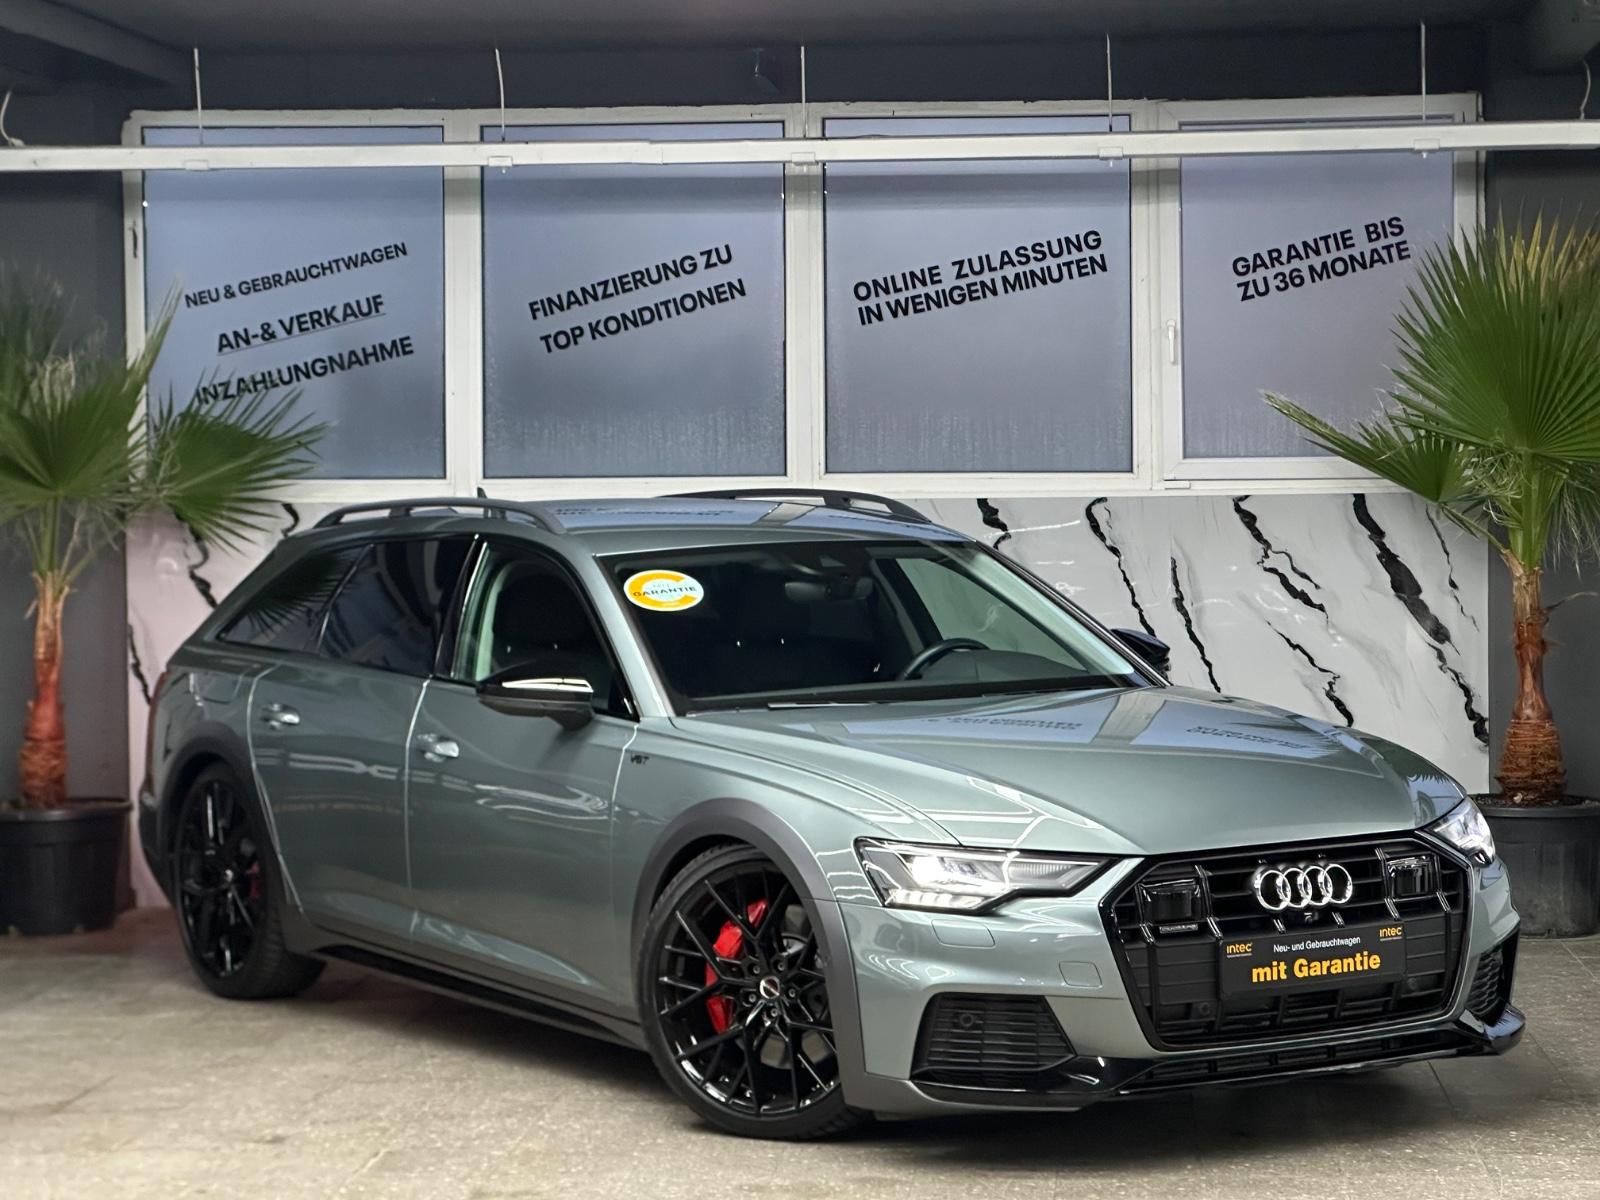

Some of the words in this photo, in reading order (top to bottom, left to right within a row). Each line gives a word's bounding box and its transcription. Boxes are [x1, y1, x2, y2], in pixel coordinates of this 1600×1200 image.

[185, 287, 220, 308] NEU
[223, 284, 236, 299] &
[238, 242, 407, 296] GEBRAUCHTWAGEN
[853, 265, 942, 301] ONLINE
[952, 230, 1102, 280] ZULASSUNG
[1232, 229, 1356, 276] GARANTIE
[1365, 216, 1404, 243] BIS
[1237, 276, 1270, 301] ZU
[1274, 268, 1305, 291] 36
[1309, 240, 1411, 283] MONATE
[528, 255, 698, 320] FINANZIERUNG
[700, 244, 732, 270] ZU
[858, 303, 883, 326] IN
[886, 278, 998, 319] WENIGEN
[1002, 254, 1108, 294] MINUTEN
[278, 294, 385, 336] VERKAUF
[540, 325, 584, 353] TOP
[588, 278, 746, 340] KONDITIONEN
[633, 586, 697, 597] GARANTIE
[1226, 942, 1253, 953] intec
[1273, 943, 1290, 953] Neu-
[1291, 941, 1305, 951] und
[1306, 936, 1361, 950] Gebrauchtwagen
[1379, 927, 1402, 937] intec
[1251, 961, 1287, 983] mit
[1294, 951, 1381, 978] Garantie
